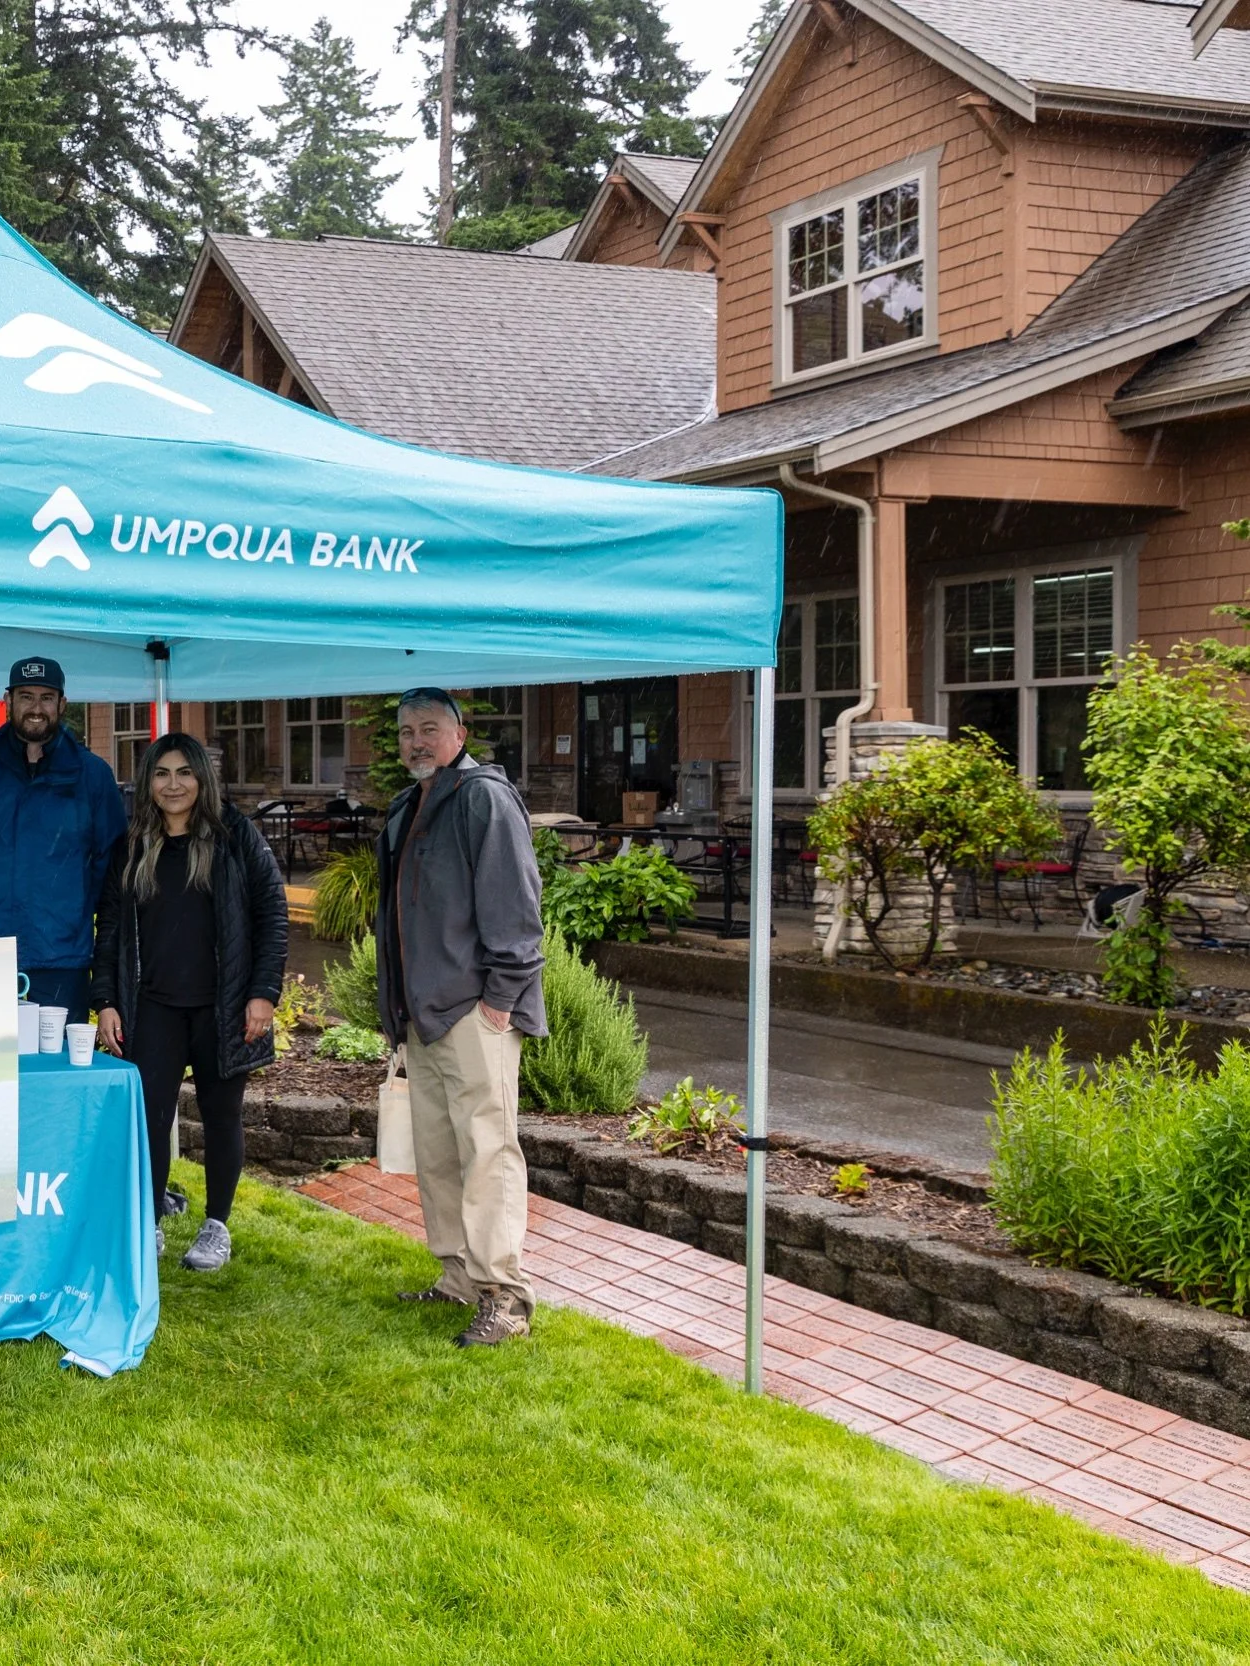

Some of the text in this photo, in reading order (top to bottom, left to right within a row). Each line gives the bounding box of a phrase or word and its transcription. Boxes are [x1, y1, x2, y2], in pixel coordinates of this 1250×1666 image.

[110, 514, 425, 574] UMPQUA BANK
[4, 1293, 24, 1304] FDIC
